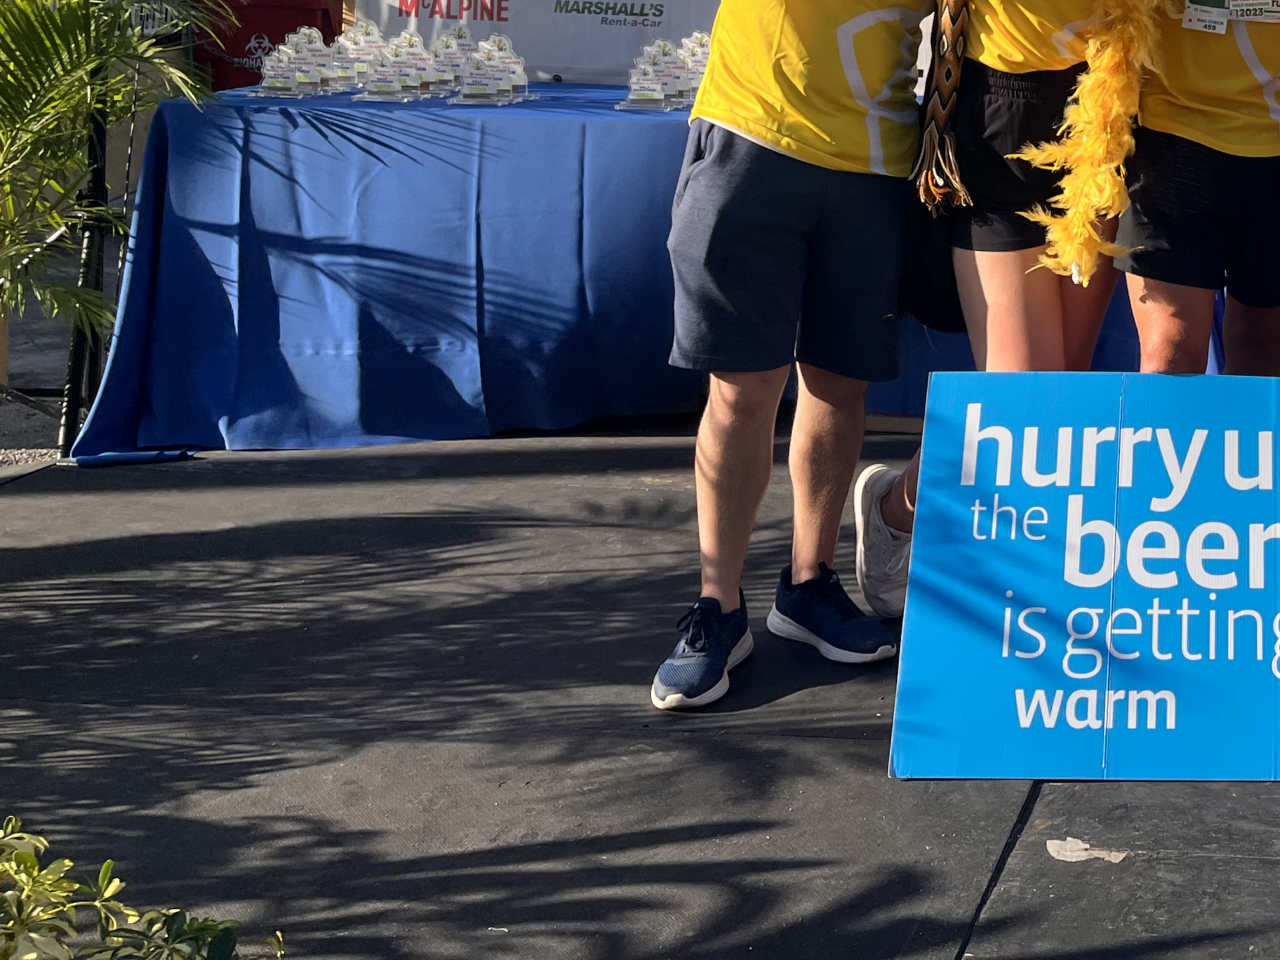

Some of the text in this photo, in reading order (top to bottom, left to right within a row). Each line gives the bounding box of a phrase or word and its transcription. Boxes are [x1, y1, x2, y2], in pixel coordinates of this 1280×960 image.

[600, 16, 663, 28] Rent-a-Car
[1239, 8, 1265, 18] 2023
[960, 402, 1209, 513] hurry
[971, 493, 1049, 541] the
[1001, 590, 1048, 660] is
[1014, 688, 1177, 731] warm
